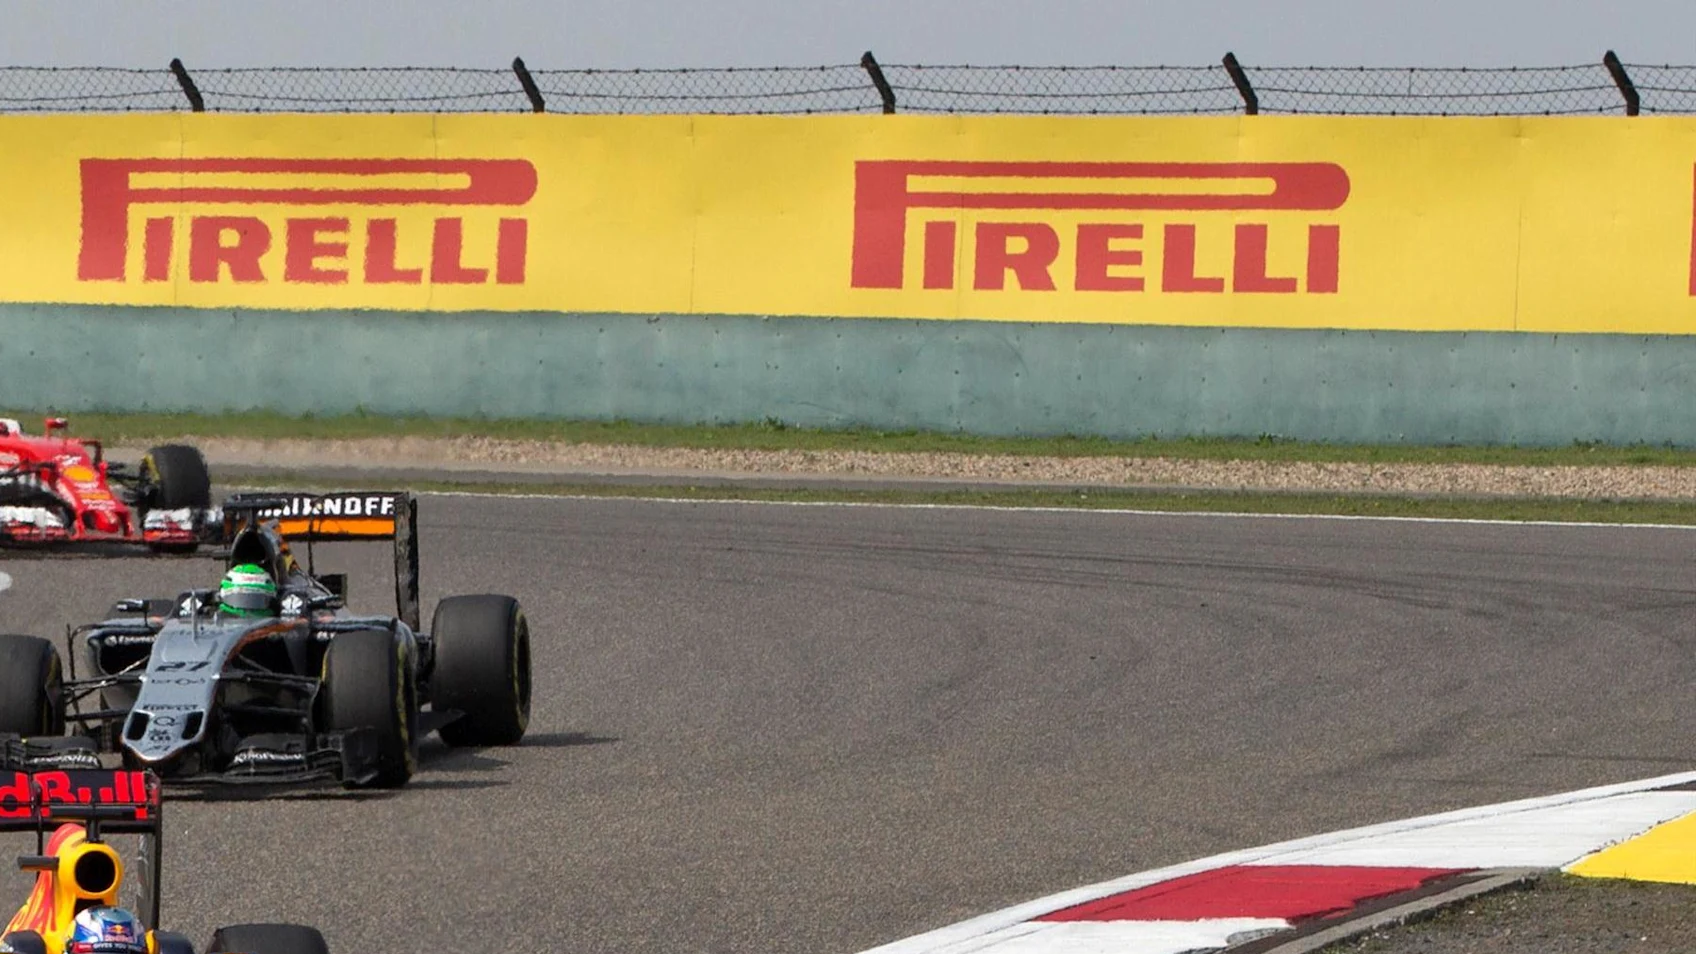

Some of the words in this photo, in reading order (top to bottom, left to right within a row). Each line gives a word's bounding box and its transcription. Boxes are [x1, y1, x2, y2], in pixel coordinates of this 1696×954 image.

[77, 158, 538, 285] PIRELLI
[850, 160, 1351, 294] PIRELLI
[257, 497, 395, 517] IRNOFF
[32, 770, 148, 820] Bull
